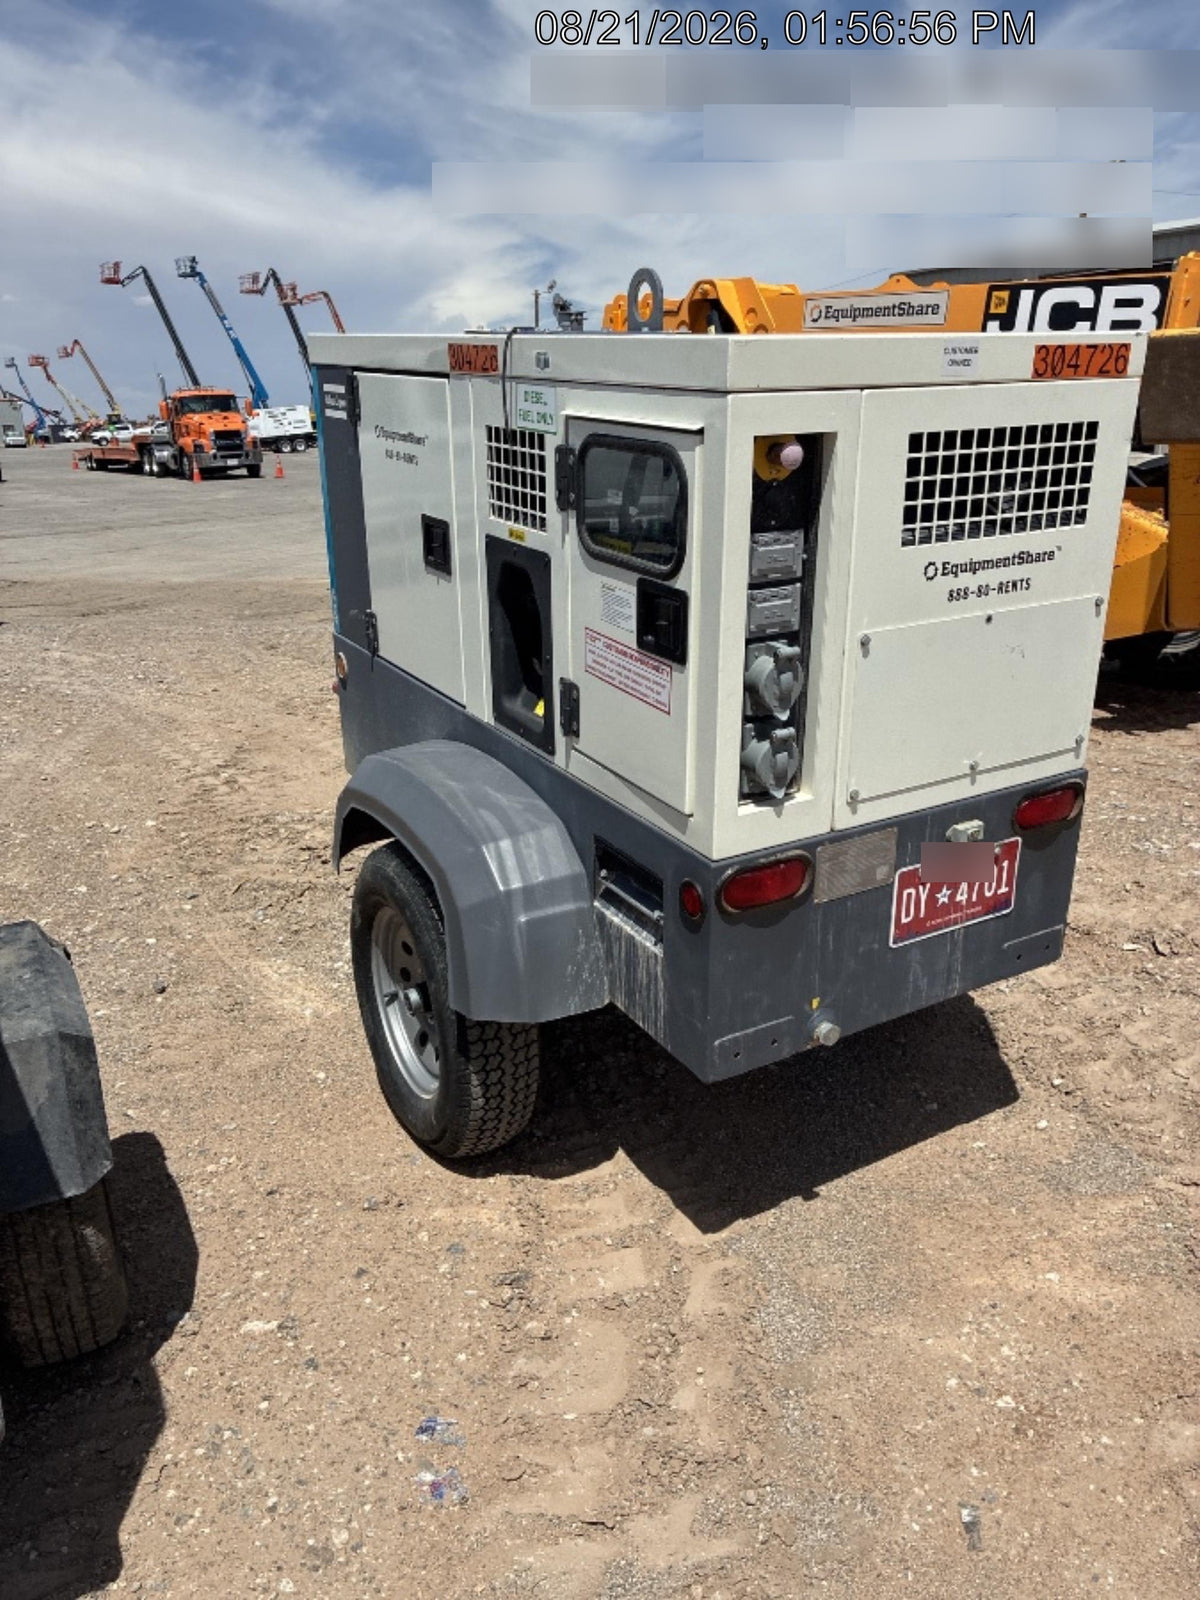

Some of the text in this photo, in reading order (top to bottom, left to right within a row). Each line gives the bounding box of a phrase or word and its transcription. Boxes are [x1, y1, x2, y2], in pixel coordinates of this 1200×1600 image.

[823, 300, 940, 322] EquipmentShare
[986, 283, 1162, 332] JCB
[1034, 343, 1129, 377] 304726
[940, 550, 1056, 577] EquipmentShare
[901, 882, 931, 924] DY
